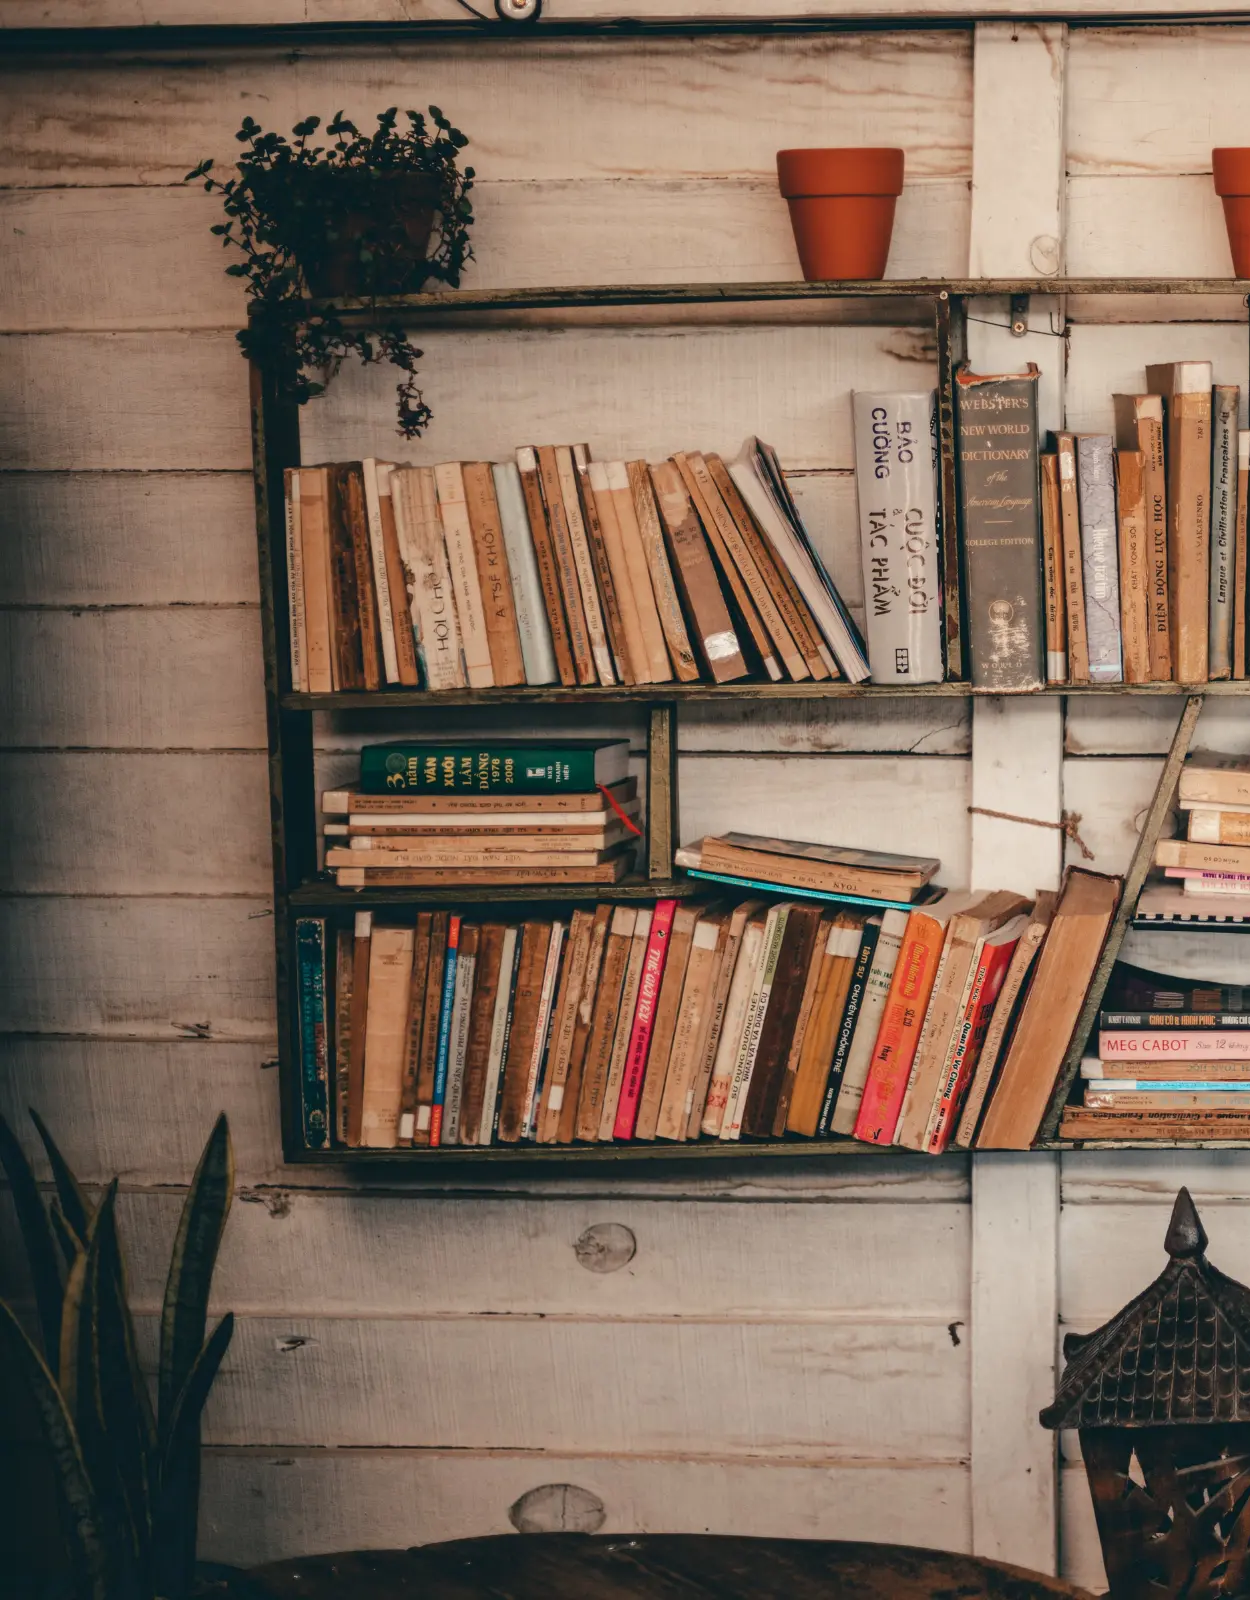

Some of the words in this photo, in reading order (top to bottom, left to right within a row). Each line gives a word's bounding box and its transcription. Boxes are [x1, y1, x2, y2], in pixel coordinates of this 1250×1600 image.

[960, 398, 1028, 410] WEBSTER'S
[961, 426, 986, 436] NEW
[988, 424, 1030, 435] WORLD
[872, 408, 892, 478] CƯỜNG
[896, 422, 918, 463] BẢO
[961, 449, 1030, 461] DICTIONARY
[1220, 428, 1230, 484] Françaises
[1154, 495, 1163, 521] HỌC
[1218, 489, 1228, 546] Civilisation
[868, 508, 892, 547] TÁC
[898, 508, 930, 566] CUỘC
[966, 539, 998, 547] COLLEGE
[1000, 537, 1034, 546] EDITION
[1154, 529, 1164, 552] LỰC
[1220, 552, 1225, 560] et
[871, 558, 899, 616] PHẨM
[1154, 560, 1166, 595] ĐỘNG
[1217, 566, 1226, 603] Langue
[907, 578, 934, 613] ĐỜI
[1154, 603, 1167, 631] ĐIỆN
[406, 756, 418, 786] năm
[424, 757, 437, 784] VĂN
[441, 756, 456, 787] XUÔI
[459, 757, 472, 786] LÂM
[474, 752, 489, 790] ĐỒNG
[491, 758, 500, 783] 1978
[504, 758, 514, 784] 2008
[833, 882, 856, 891] TOÁN
[764, 949, 777, 973] TAKASHI
[772, 916, 785, 949] MASSUMOTO
[859, 945, 872, 964] tâm
[647, 948, 662, 973] THẾ
[855, 965, 865, 978] sự
[642, 972, 658, 997] GIỚI
[975, 965, 986, 984] THẮC
[459, 996, 468, 1010] TÂY
[750, 992, 758, 1011] NÉT
[760, 991, 769, 1003] CỤ
[848, 984, 861, 1016] CHUYỆN
[972, 988, 980, 1001] MẮC
[566, 1002, 574, 1020] NAM
[638, 998, 652, 1024] YÊU
[754, 1005, 766, 1028] DỤNG
[843, 1016, 854, 1028] VỢ
[964, 1003, 974, 1021] trong
[1165, 1014, 1173, 1024] CÓ
[1198, 1014, 1215, 1025] PHÚC
[456, 1011, 467, 1047] PHƯƠNG
[562, 1023, 571, 1040] VIỆT
[702, 1055, 712, 1073] LỊCH
[709, 1023, 719, 1039] VIỆT
[715, 1003, 723, 1020] NAM
[742, 1015, 754, 1050] ĐƯỜNG
[752, 1028, 760, 1040] VÀ
[960, 1022, 971, 1044] Quan
[836, 1028, 852, 1057] CHỒNG
[877, 1043, 891, 1062] thay
[956, 1044, 965, 1057] Hệ
[1108, 1040, 1137, 1050] MEG
[1142, 1040, 1188, 1050] CABOT
[1215, 1040, 1226, 1049] 12
[1228, 1042, 1248, 1051] không
[454, 1049, 464, 1065] HỌC
[734, 1054, 745, 1082] DỤNG
[832, 1057, 844, 1072] TRẺ
[952, 1058, 961, 1070] Vợ
[453, 1067, 461, 1081] VĂN
[731, 1086, 738, 1099] SỬ
[944, 1072, 958, 1100] Chồng
[822, 1099, 830, 1116] THANH
[1148, 1111, 1200, 1120] Civilisation
[818, 1116, 826, 1129] NIÊN
[963, 1122, 973, 1139] 1977
